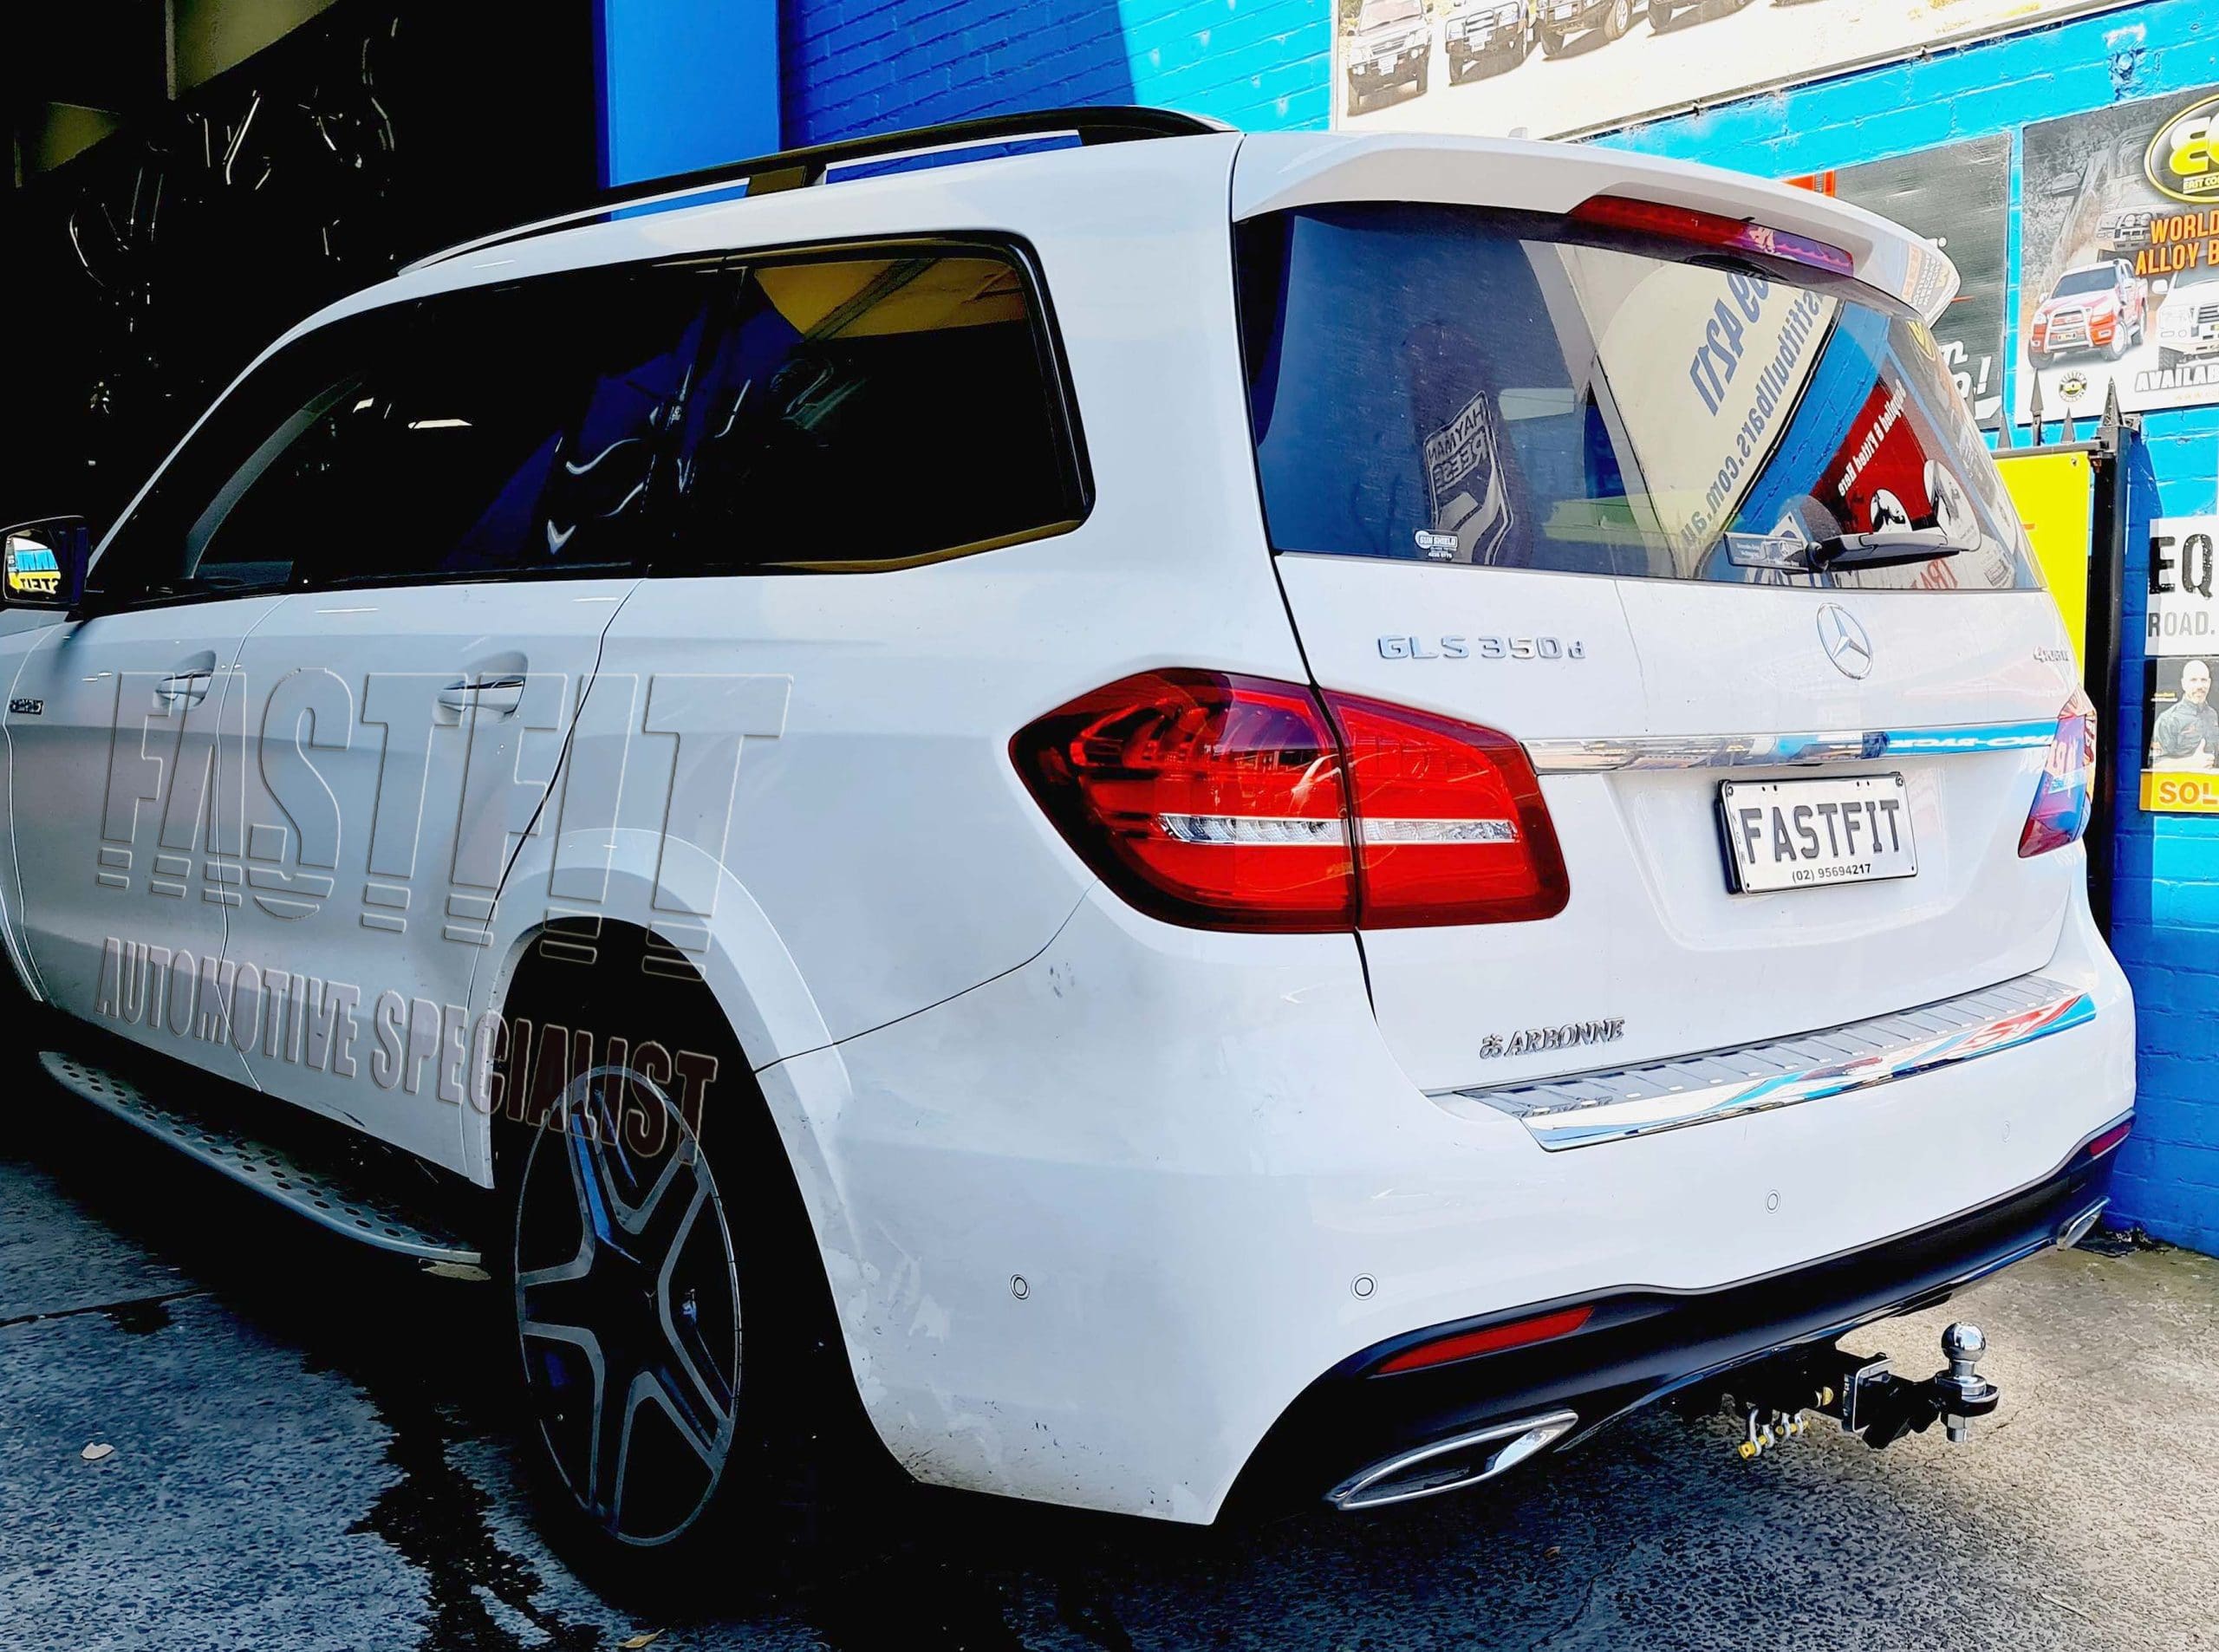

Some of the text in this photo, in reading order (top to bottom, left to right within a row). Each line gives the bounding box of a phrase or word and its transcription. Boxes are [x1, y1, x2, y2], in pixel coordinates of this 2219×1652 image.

[2150, 209, 2219, 244] WORLD
[2135, 242, 2200, 276] ALLOY
[2149, 534, 2213, 599] EQ
[2148, 611, 2215, 637] ROAD.
[1378, 636, 1586, 660] GLS 350d
[2159, 781, 2218, 804] SOL
[1739, 799, 1900, 864] FASTFIT
[1792, 863, 1871, 883] (02) 95694217
